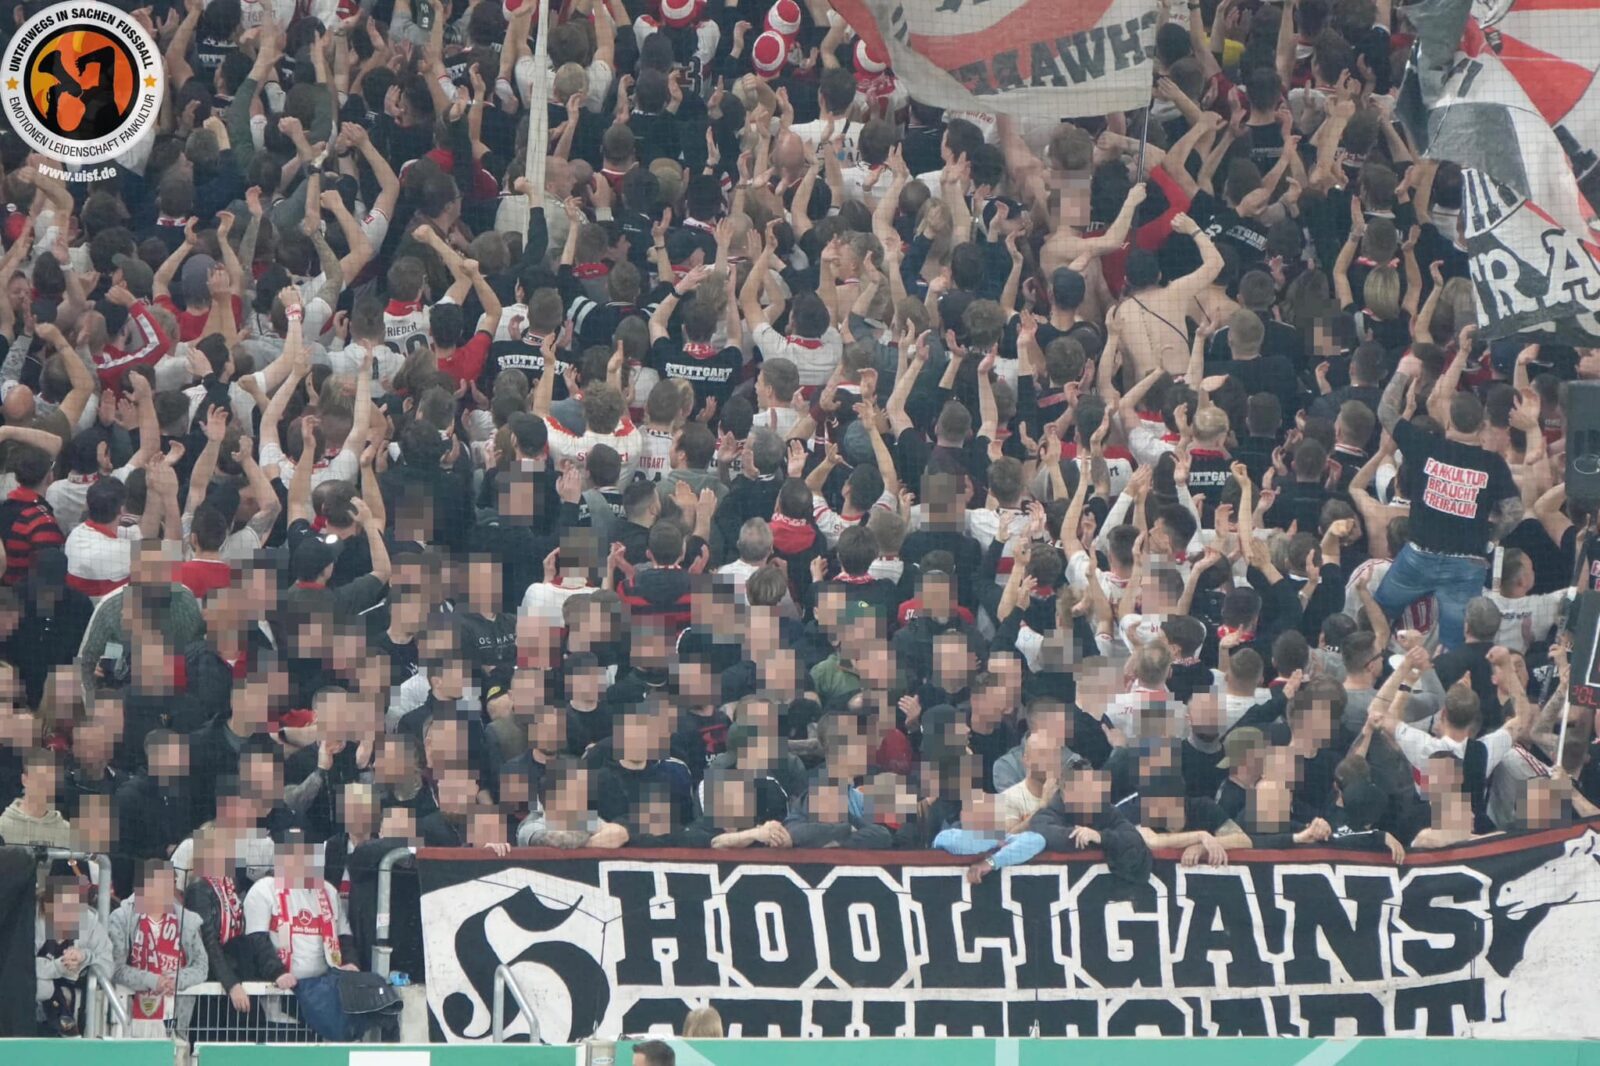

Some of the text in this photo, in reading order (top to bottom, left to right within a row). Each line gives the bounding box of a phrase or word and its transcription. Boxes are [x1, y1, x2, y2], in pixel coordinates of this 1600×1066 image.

[665, 362, 733, 380] STUTTGART
[1426, 460, 1487, 486] FANKULTUR
[1425, 490, 1476, 516] FREIRAUM
[1428, 478, 1477, 502] BRAUCHT
[605, 868, 1484, 989] HOOLIGANS
